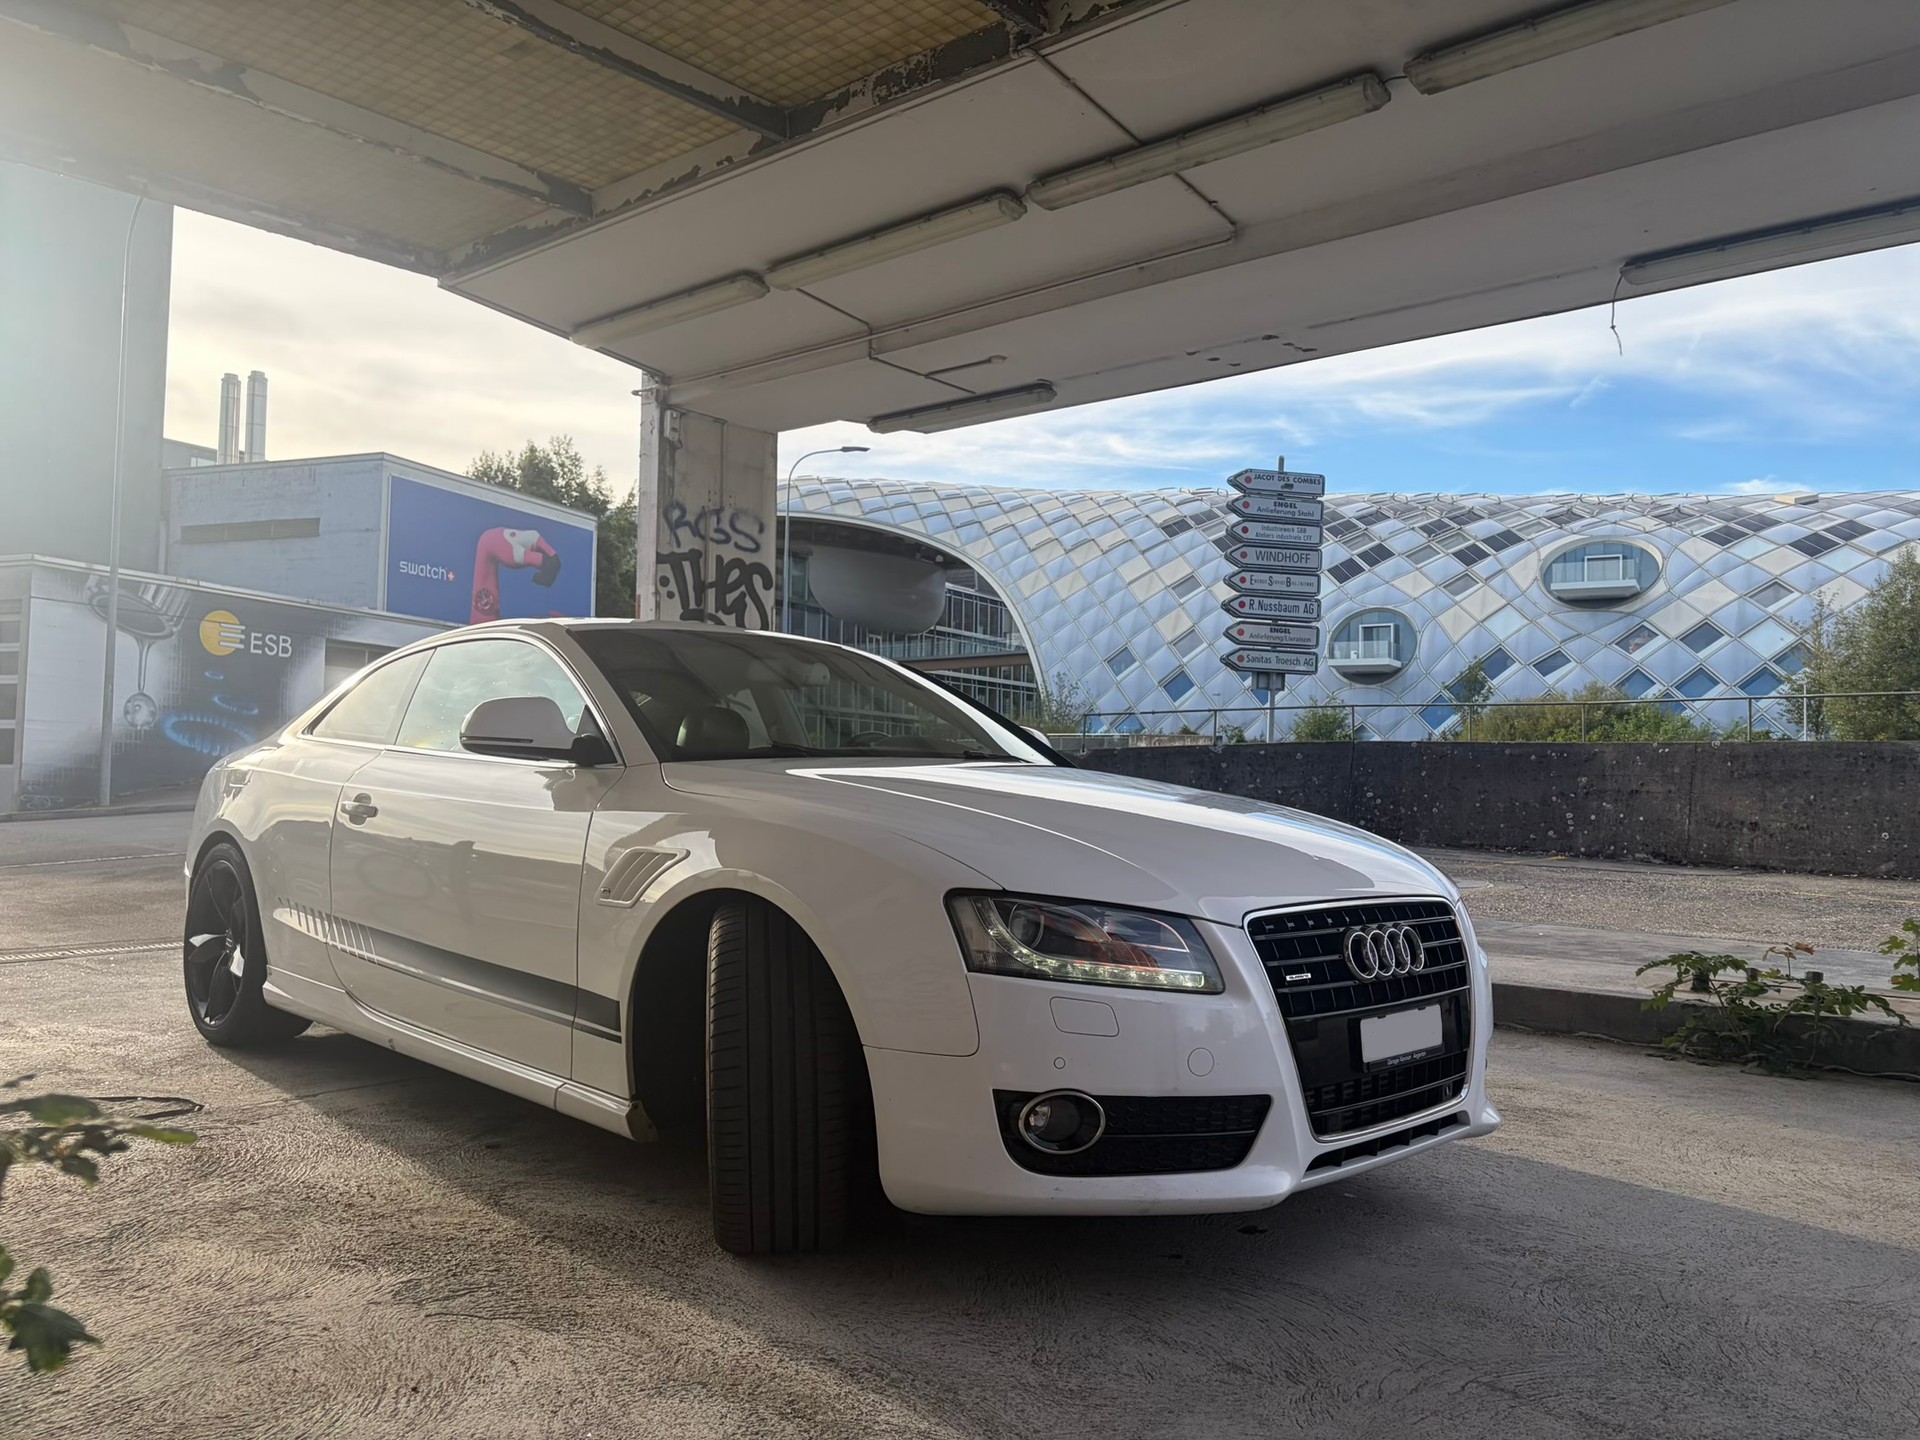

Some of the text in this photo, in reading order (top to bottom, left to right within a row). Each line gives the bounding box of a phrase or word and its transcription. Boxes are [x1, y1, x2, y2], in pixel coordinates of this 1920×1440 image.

[1293, 477, 1321, 485] COMBES
[1273, 501, 1298, 509] ENGEL
[1256, 506, 1296, 516] Anlieferung
[1261, 524, 1307, 534] Industriewerk SBB
[1255, 551, 1311, 564] WINDHOFF
[399, 560, 447, 581] swatch
[1303, 603, 1314, 614] AG
[249, 631, 292, 658] ESB
[1246, 654, 1314, 666] Sanitas Troesch AG
